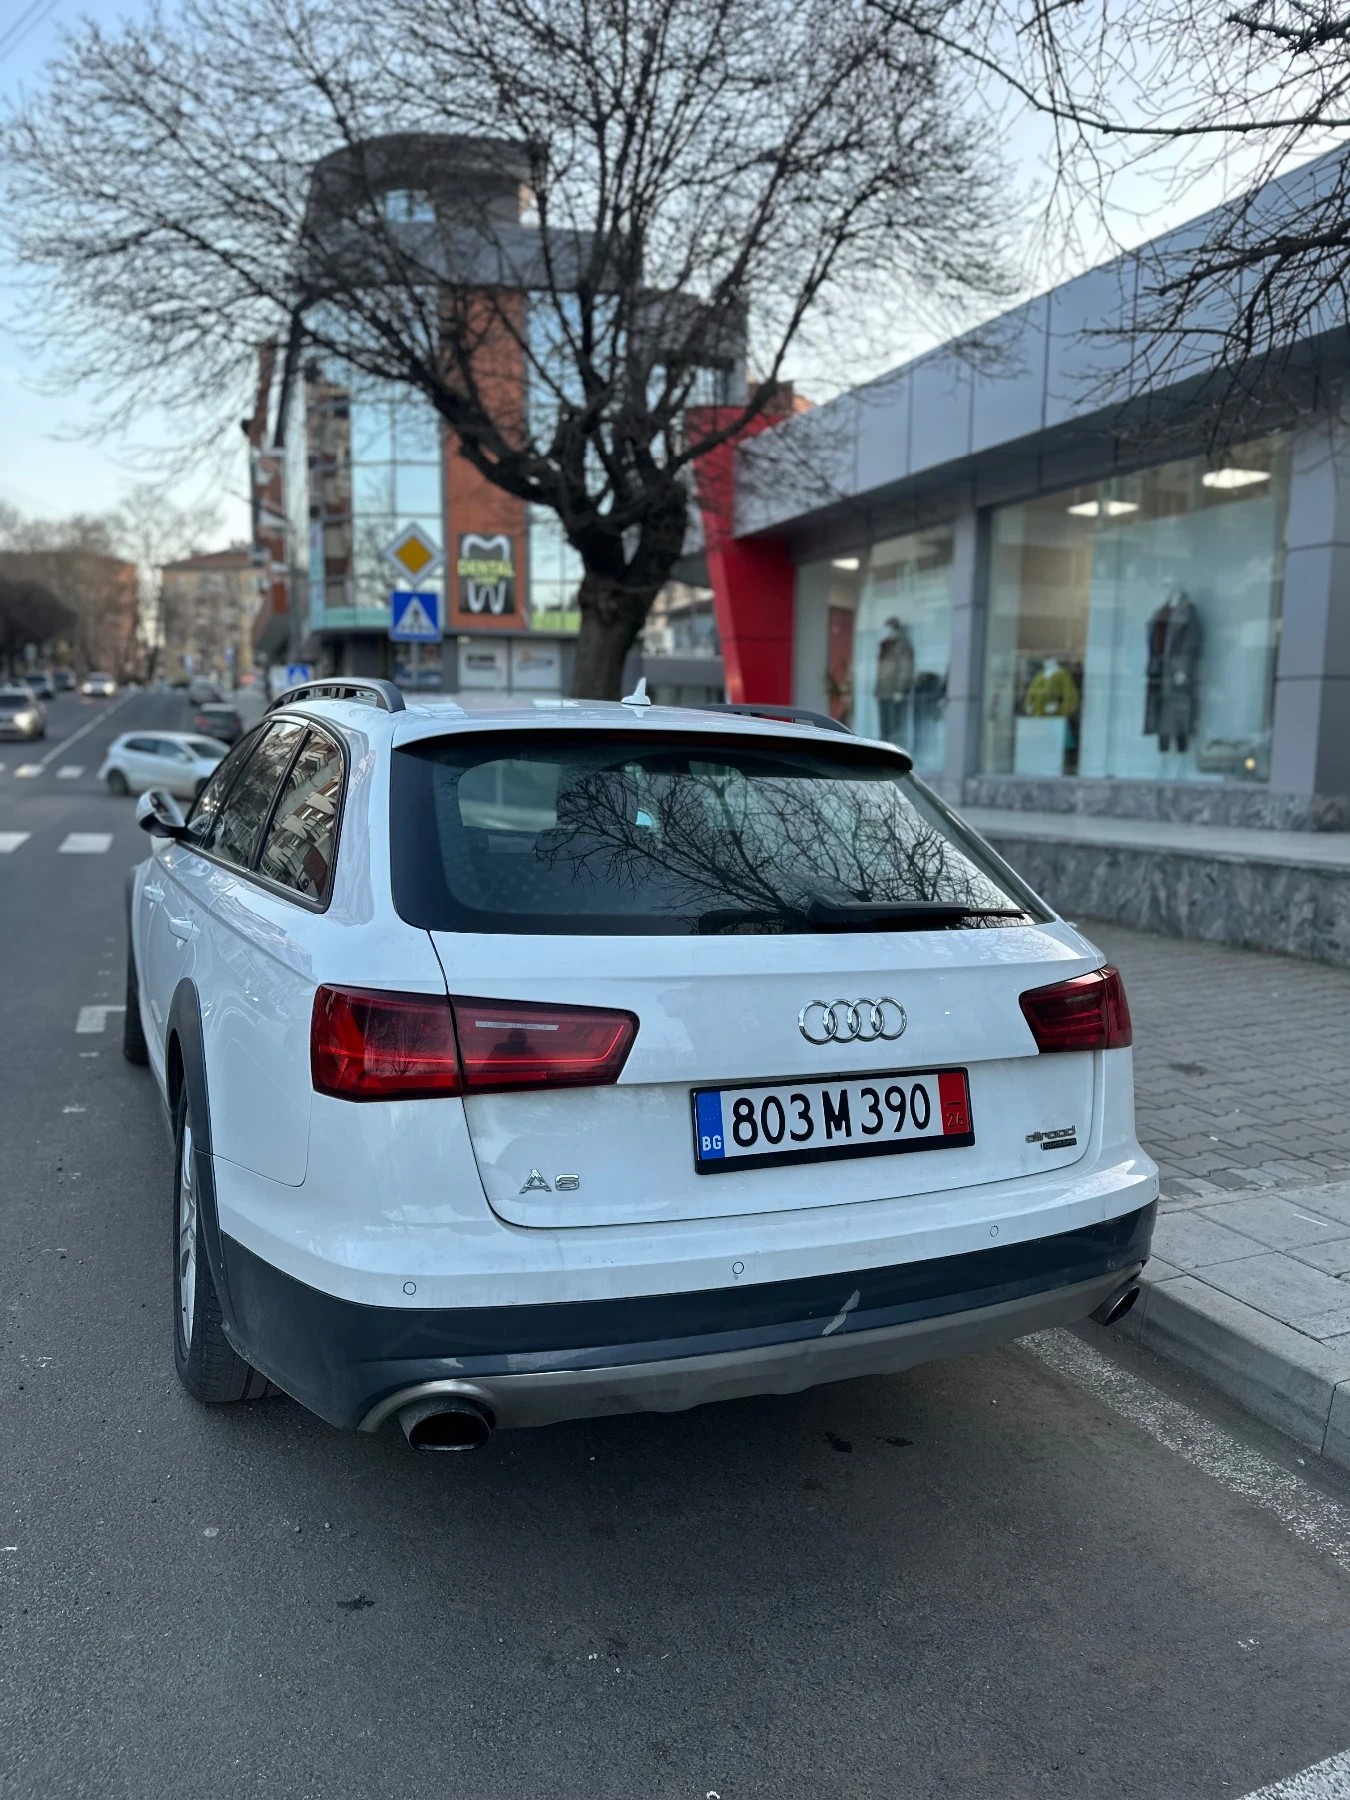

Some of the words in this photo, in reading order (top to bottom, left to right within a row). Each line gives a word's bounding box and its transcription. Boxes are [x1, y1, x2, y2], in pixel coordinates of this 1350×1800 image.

[457, 559, 515, 577] DENTAL
[732, 1093, 814, 1147] 803
[821, 1089, 852, 1140] M
[860, 1083, 931, 1135] 390
[946, 1112, 964, 1128] 26
[702, 1134, 722, 1151] BG
[1025, 1125, 1076, 1143] allroad
[1043, 1139, 1077, 1150] quattro
[519, 1169, 580, 1194] A6
